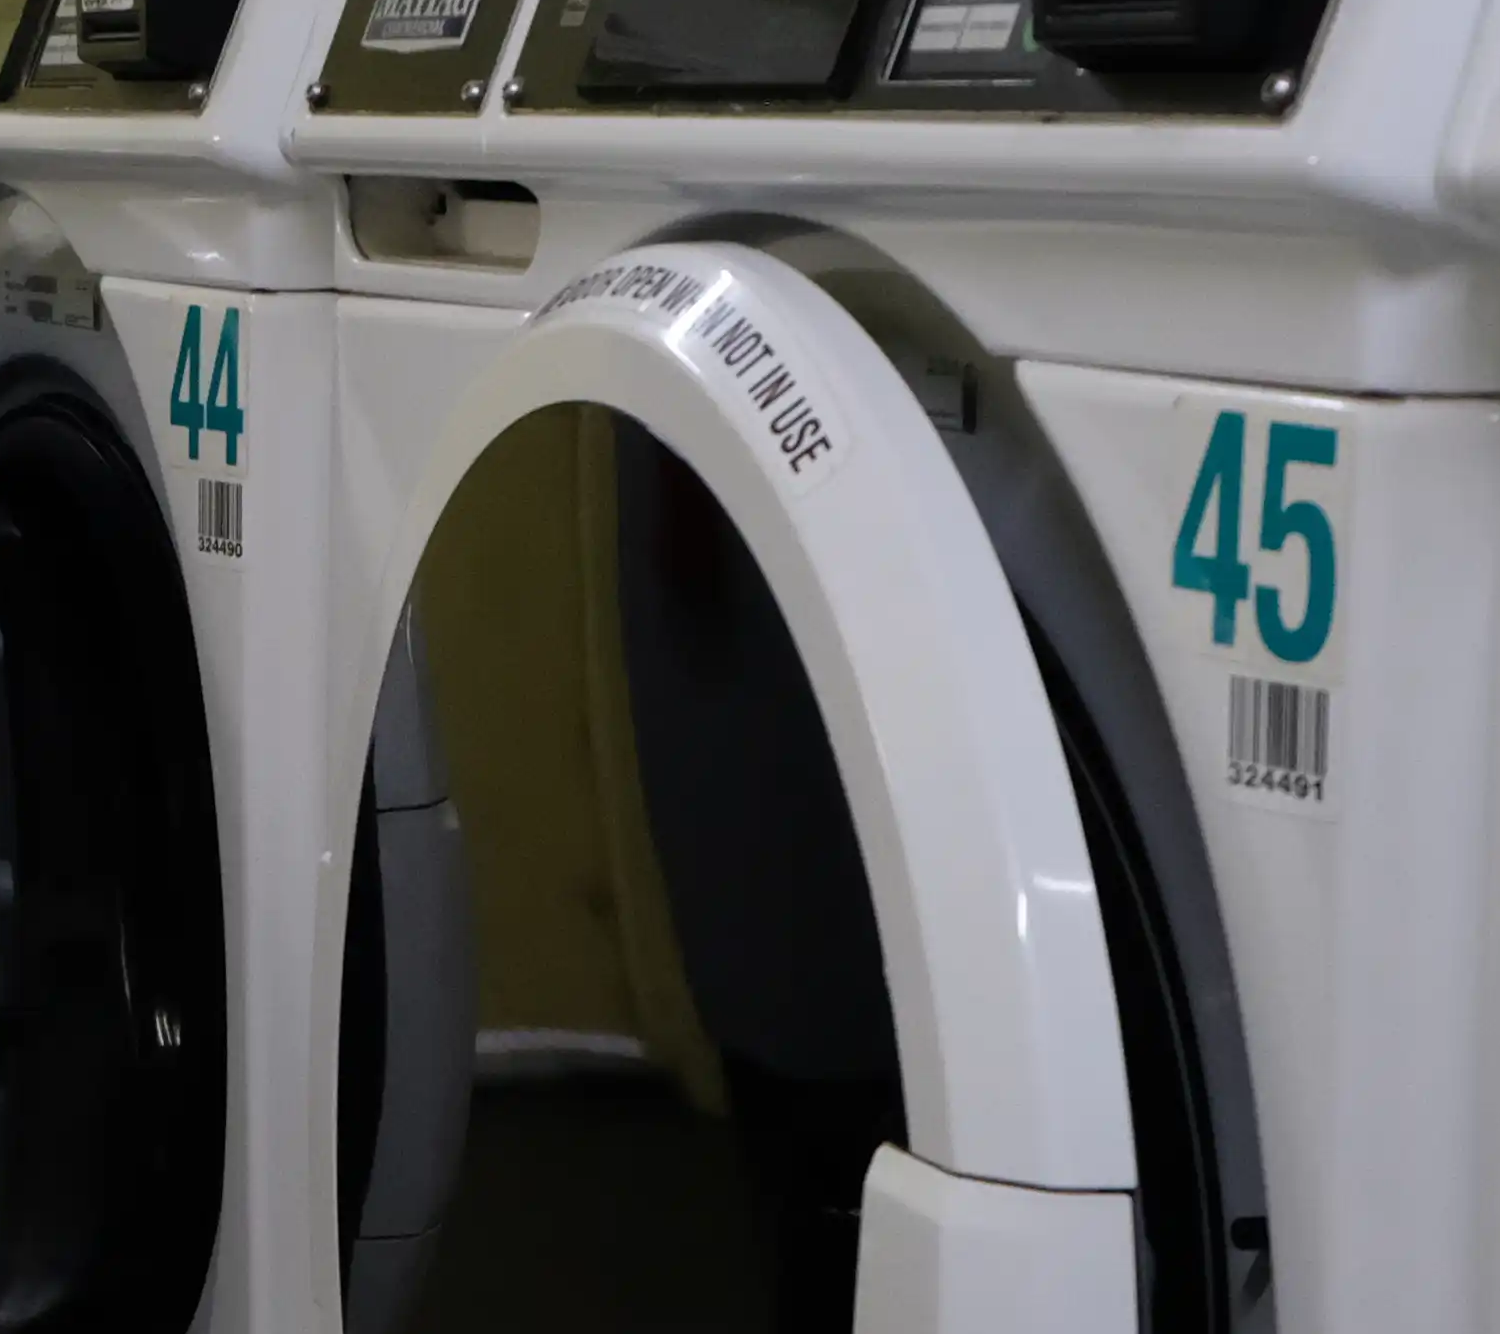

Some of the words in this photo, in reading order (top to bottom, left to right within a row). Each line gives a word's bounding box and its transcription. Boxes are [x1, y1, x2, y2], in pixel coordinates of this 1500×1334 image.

[711, 315, 775, 379] NOT
[169, 304, 245, 467] 44
[747, 362, 796, 413] IN
[769, 395, 833, 475] USE
[197, 535, 244, 559] 324490
[1171, 408, 1339, 664] 45
[1227, 759, 1327, 803] 324491
